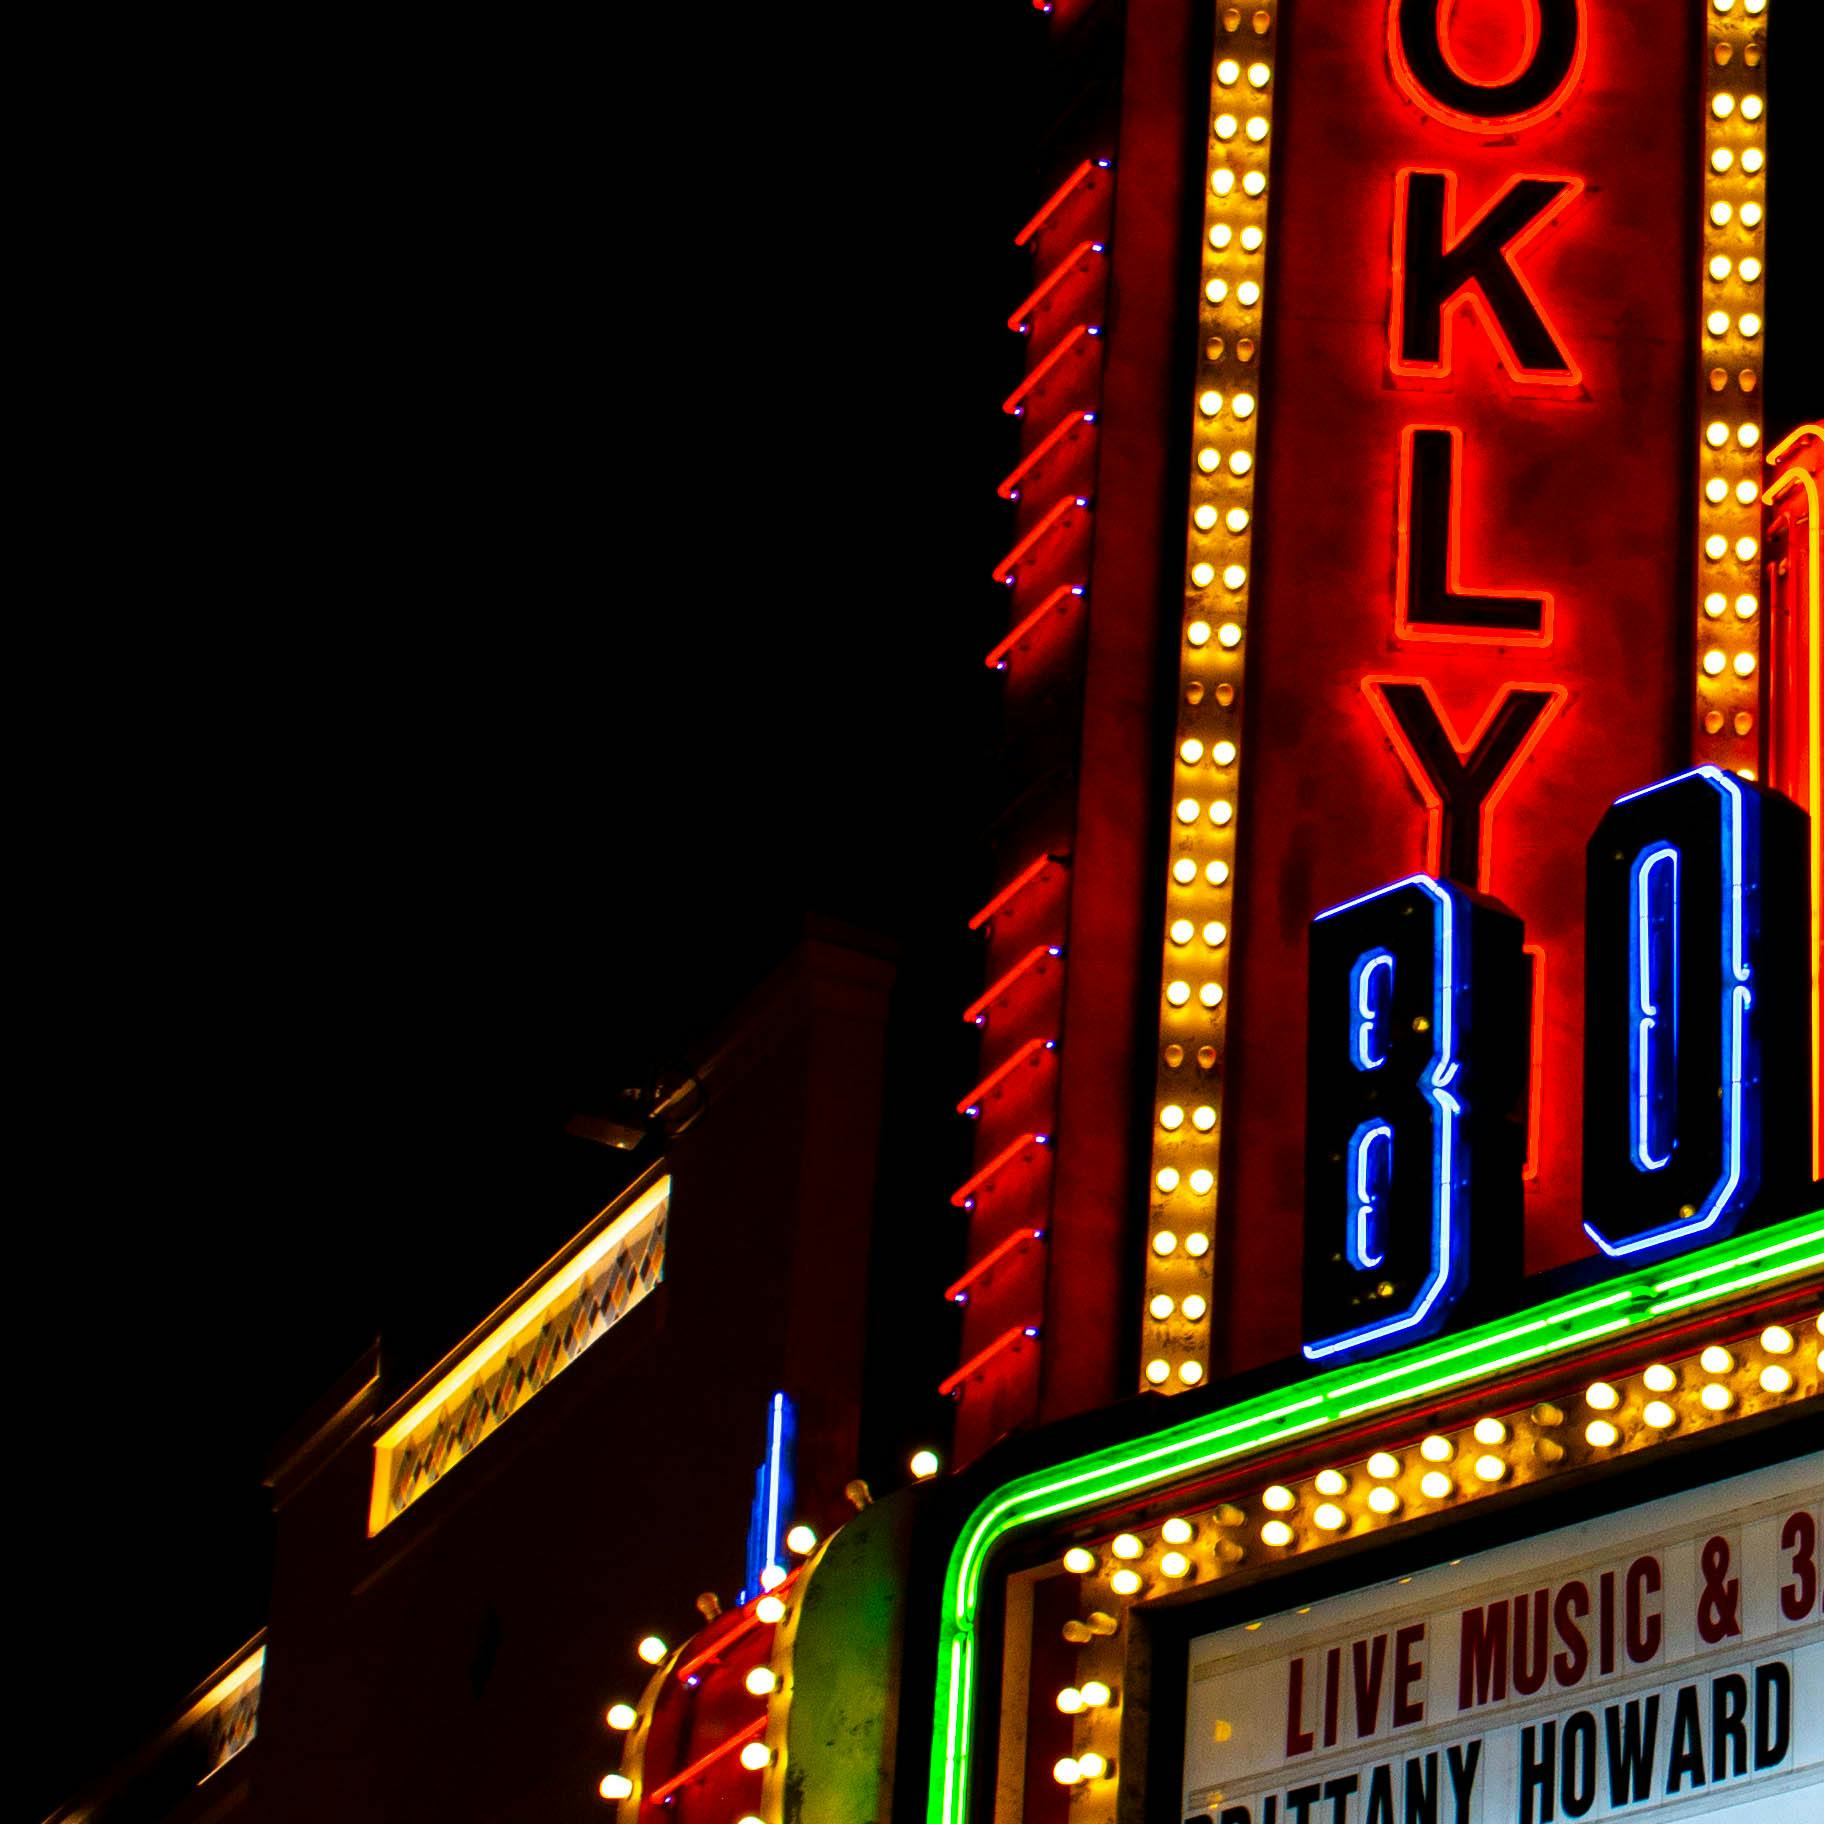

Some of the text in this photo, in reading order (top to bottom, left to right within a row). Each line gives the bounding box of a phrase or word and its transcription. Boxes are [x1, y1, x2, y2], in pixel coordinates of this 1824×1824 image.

[1286, 1623, 1425, 1757] LIVE
[1458, 1555, 1662, 1711] MUSIC
[1696, 1535, 1740, 1644] &
